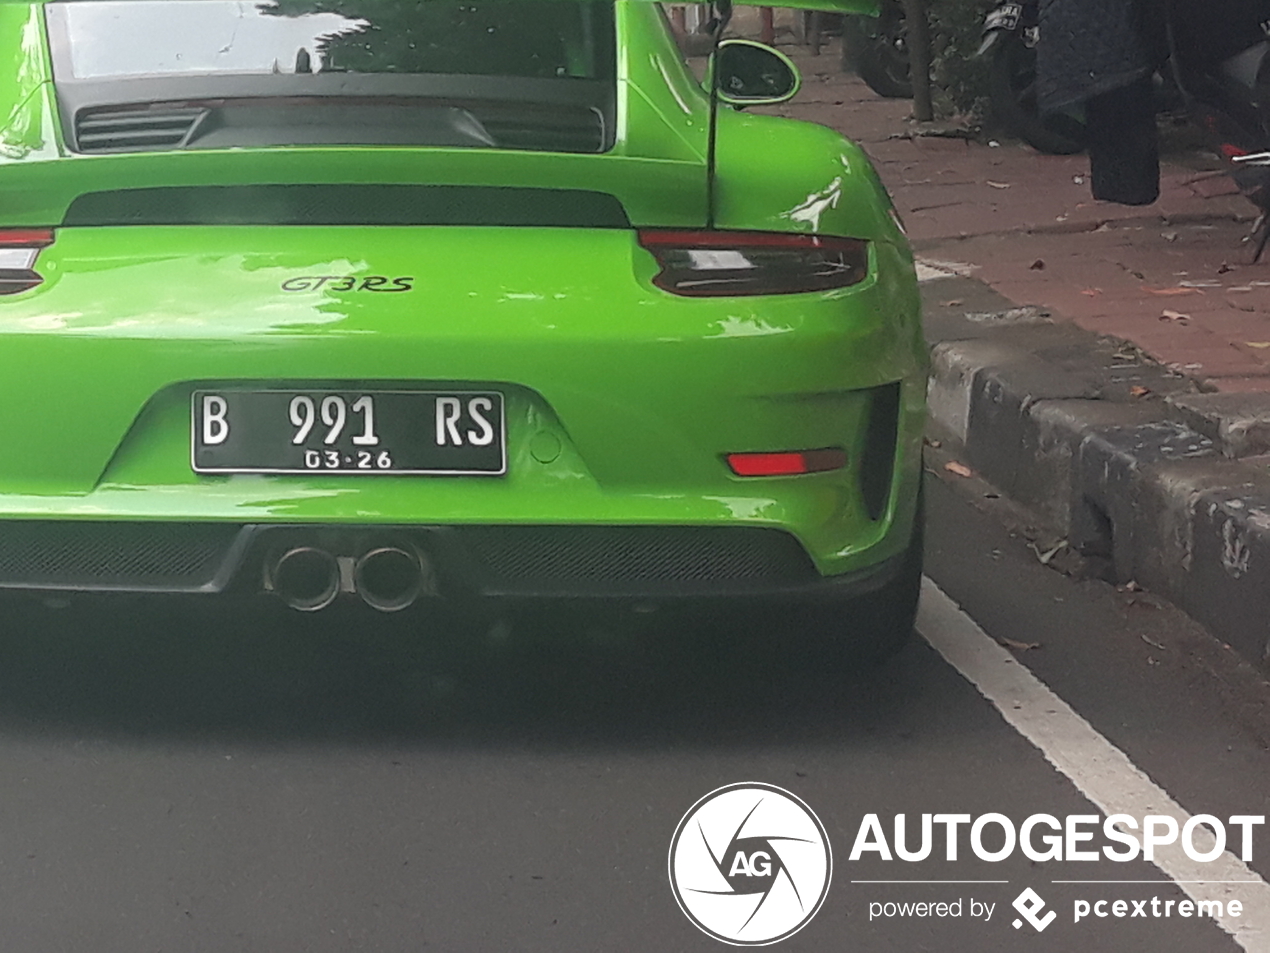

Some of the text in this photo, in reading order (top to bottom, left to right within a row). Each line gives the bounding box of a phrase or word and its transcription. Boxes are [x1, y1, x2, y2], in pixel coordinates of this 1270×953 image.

[202, 395, 494, 446] B 991 RS
